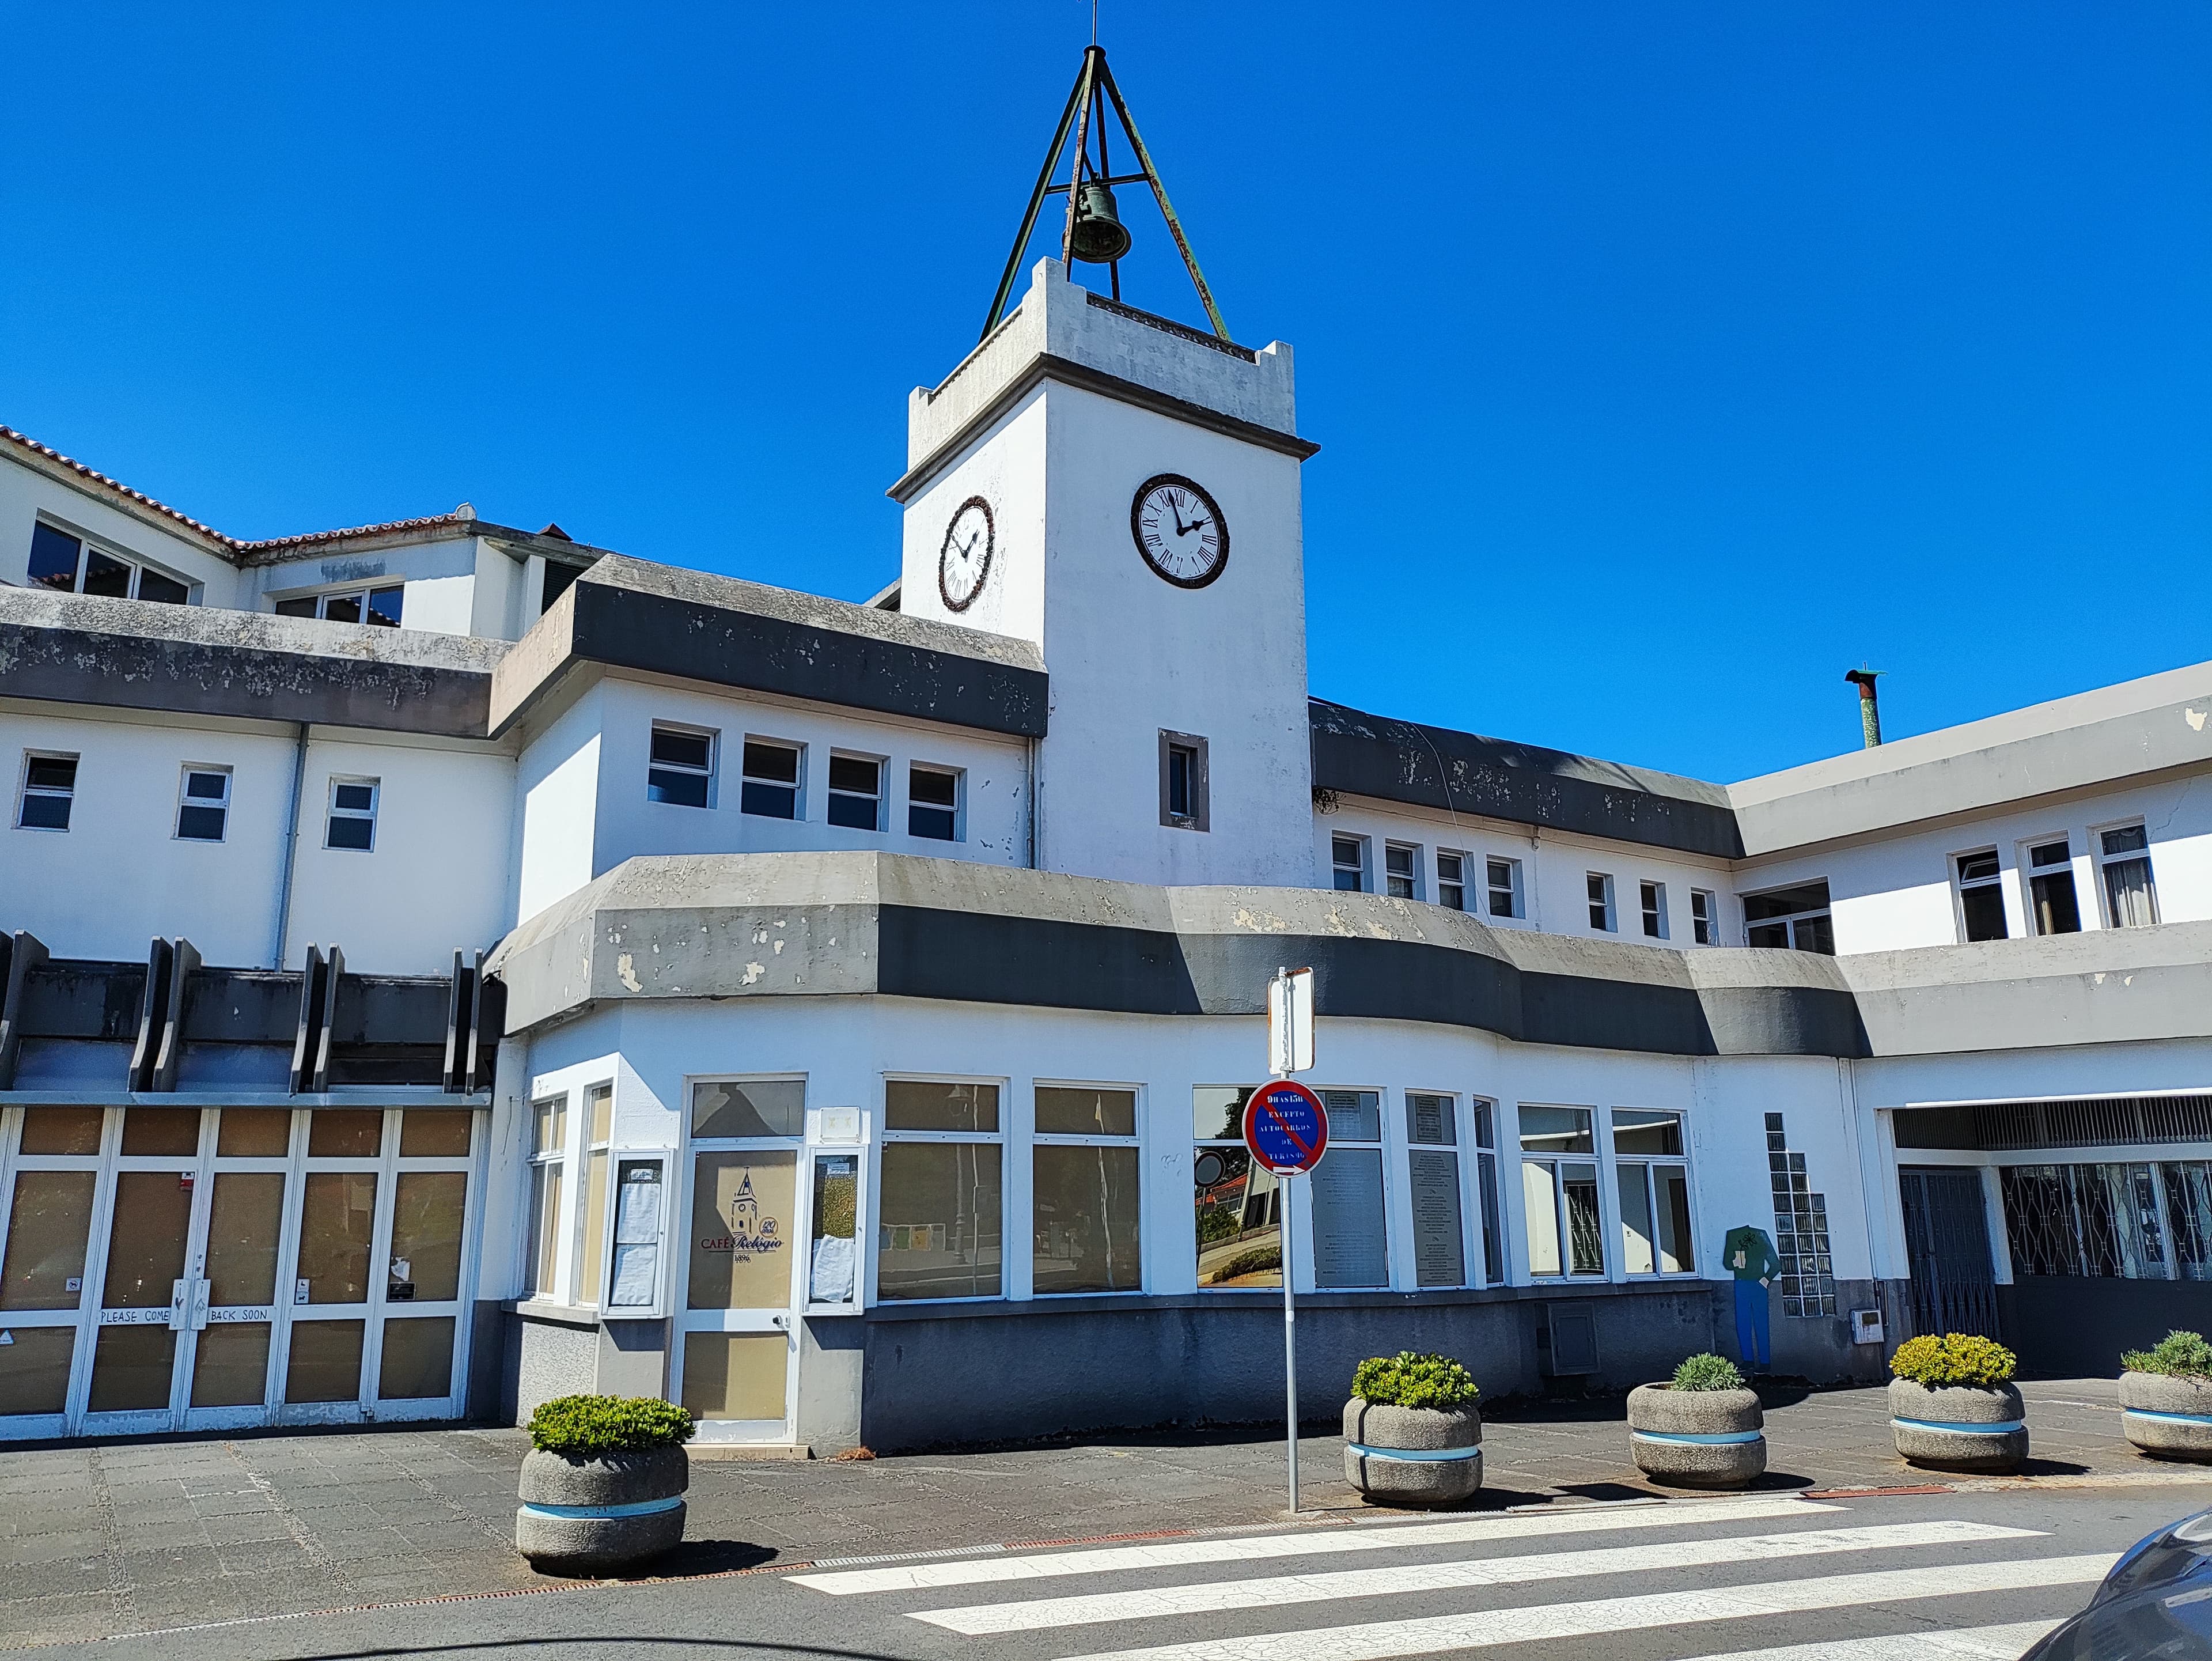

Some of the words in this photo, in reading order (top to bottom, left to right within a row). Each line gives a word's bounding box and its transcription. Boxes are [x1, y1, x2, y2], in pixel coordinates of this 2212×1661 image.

[1146, 500, 1162, 516] X
[701, 1236, 729, 1249] CAFÉ
[101, 1311, 137, 1323] PLEASE
[145, 1310, 169, 1322] COME
[211, 1310, 236, 1321] BACK
[242, 1310, 267, 1320] SOON
